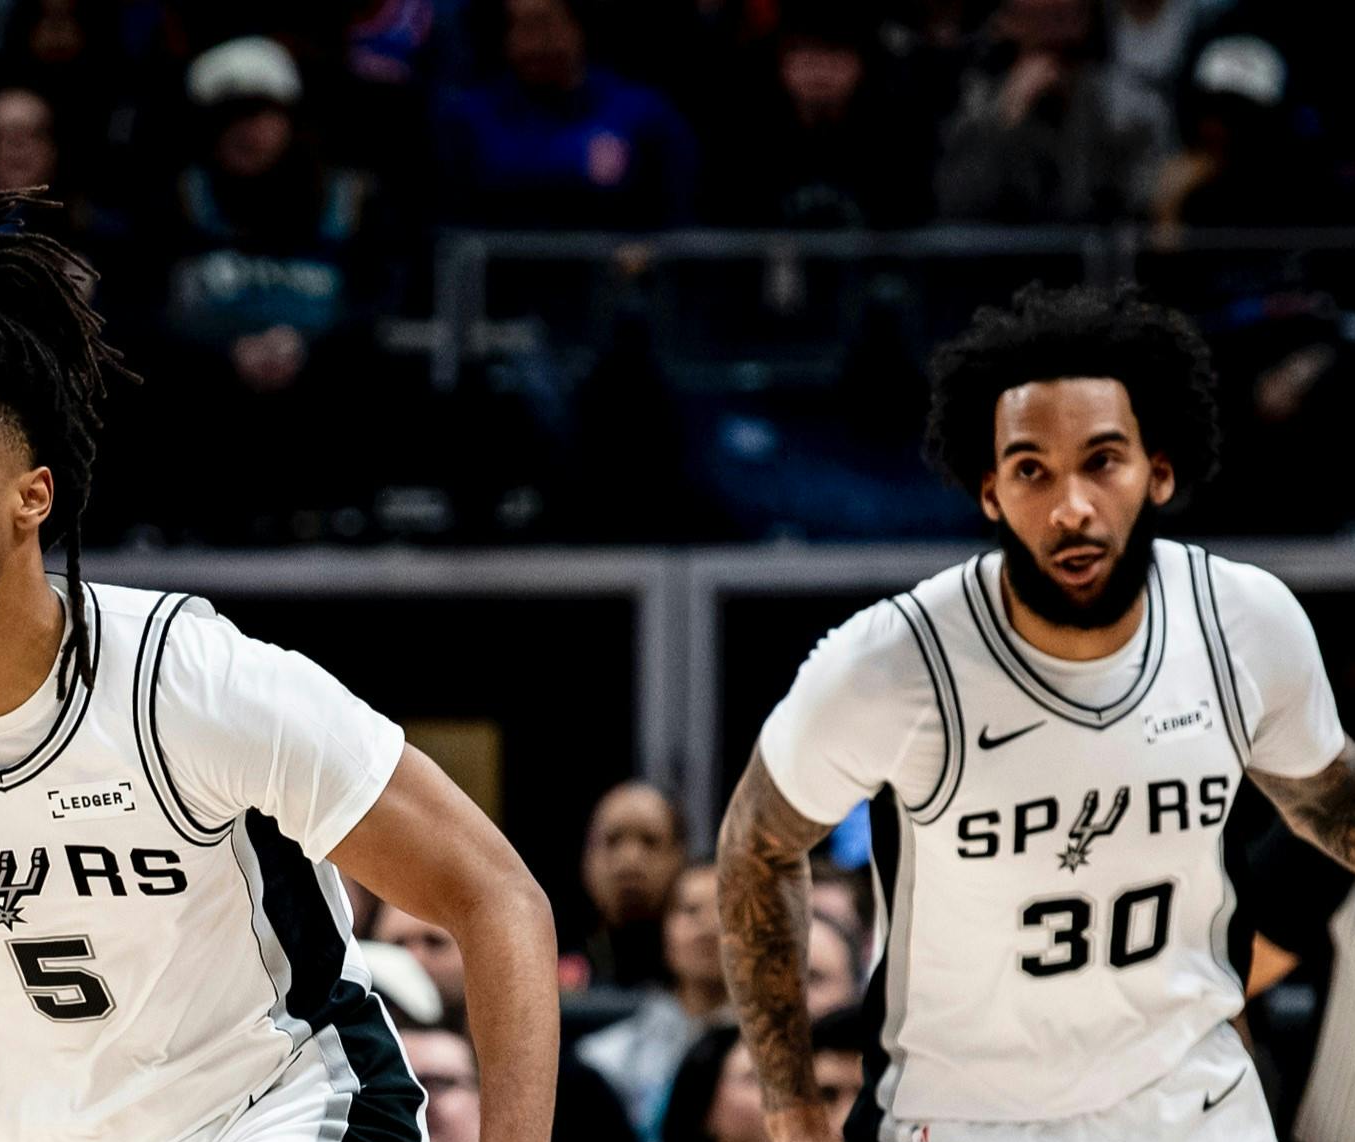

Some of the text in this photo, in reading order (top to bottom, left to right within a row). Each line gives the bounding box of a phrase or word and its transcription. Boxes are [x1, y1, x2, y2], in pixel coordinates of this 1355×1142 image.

[60, 792, 123, 810] LEDGER
[957, 776, 1228, 874] SPURS
[1018, 877, 1178, 980] 30
[5, 934, 117, 1022] 5
